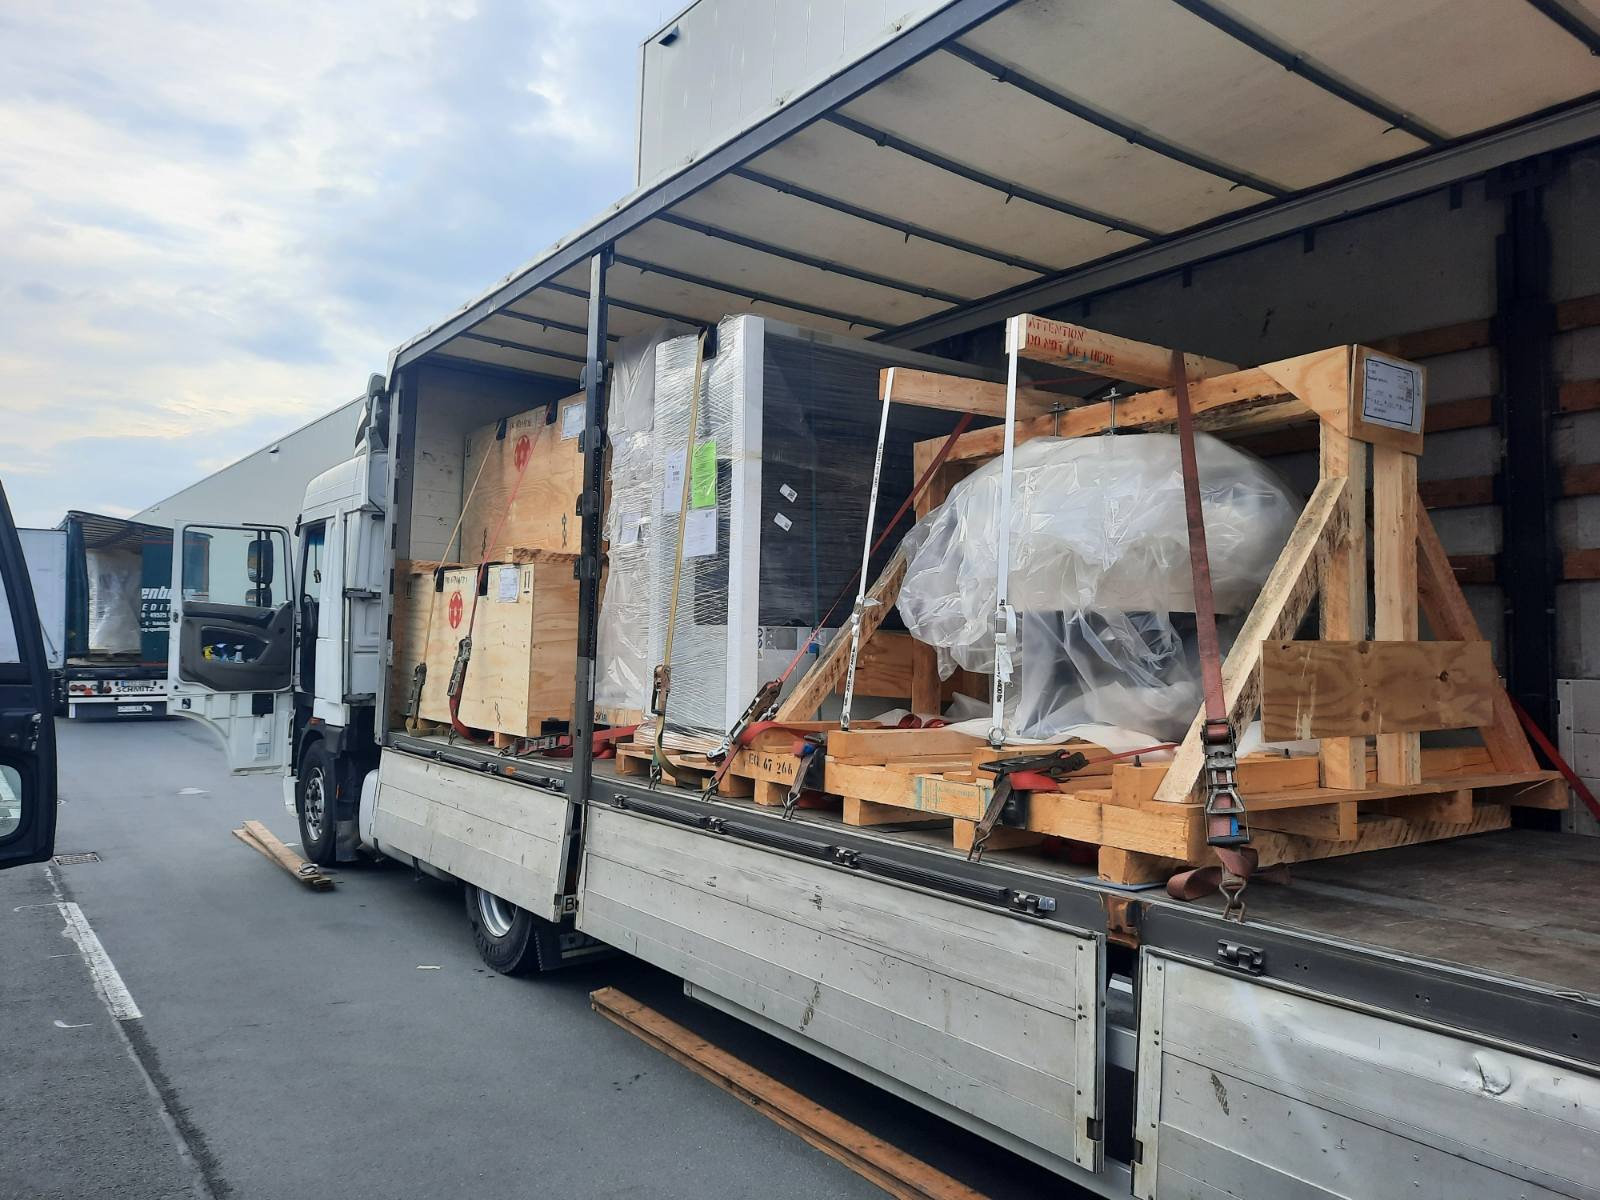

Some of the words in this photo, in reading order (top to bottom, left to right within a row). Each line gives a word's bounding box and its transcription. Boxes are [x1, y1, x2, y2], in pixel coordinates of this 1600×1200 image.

[1028, 316, 1084, 341] ATTENTION
[1027, 333, 1041, 347] DO
[1043, 336, 1063, 352] NOT
[1090, 348, 1116, 366] HERE
